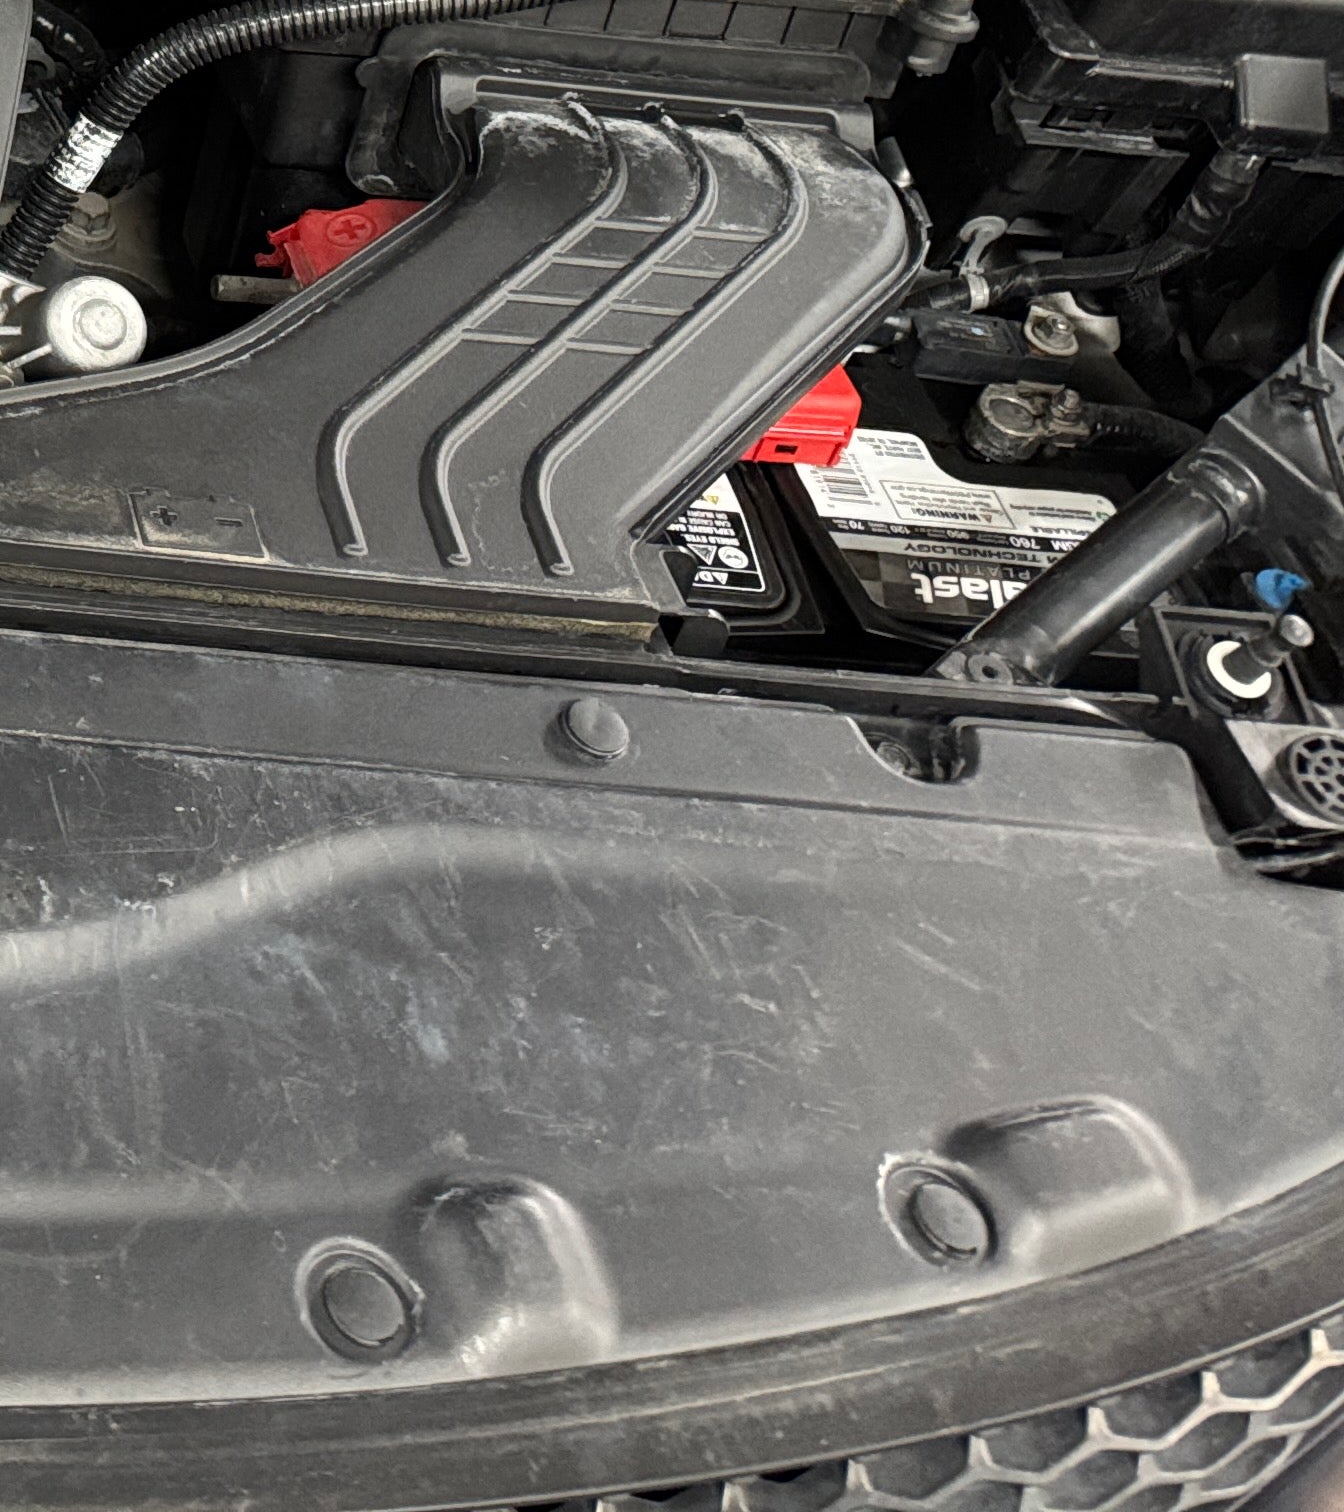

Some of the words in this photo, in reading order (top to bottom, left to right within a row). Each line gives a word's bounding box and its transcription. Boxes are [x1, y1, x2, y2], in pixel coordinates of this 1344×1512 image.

[848, 519, 865, 530] 70
[1009, 535, 1042, 551] 760
[903, 542, 1042, 564] TECHNOLOGY
[906, 559, 1033, 581] PLATINUM
